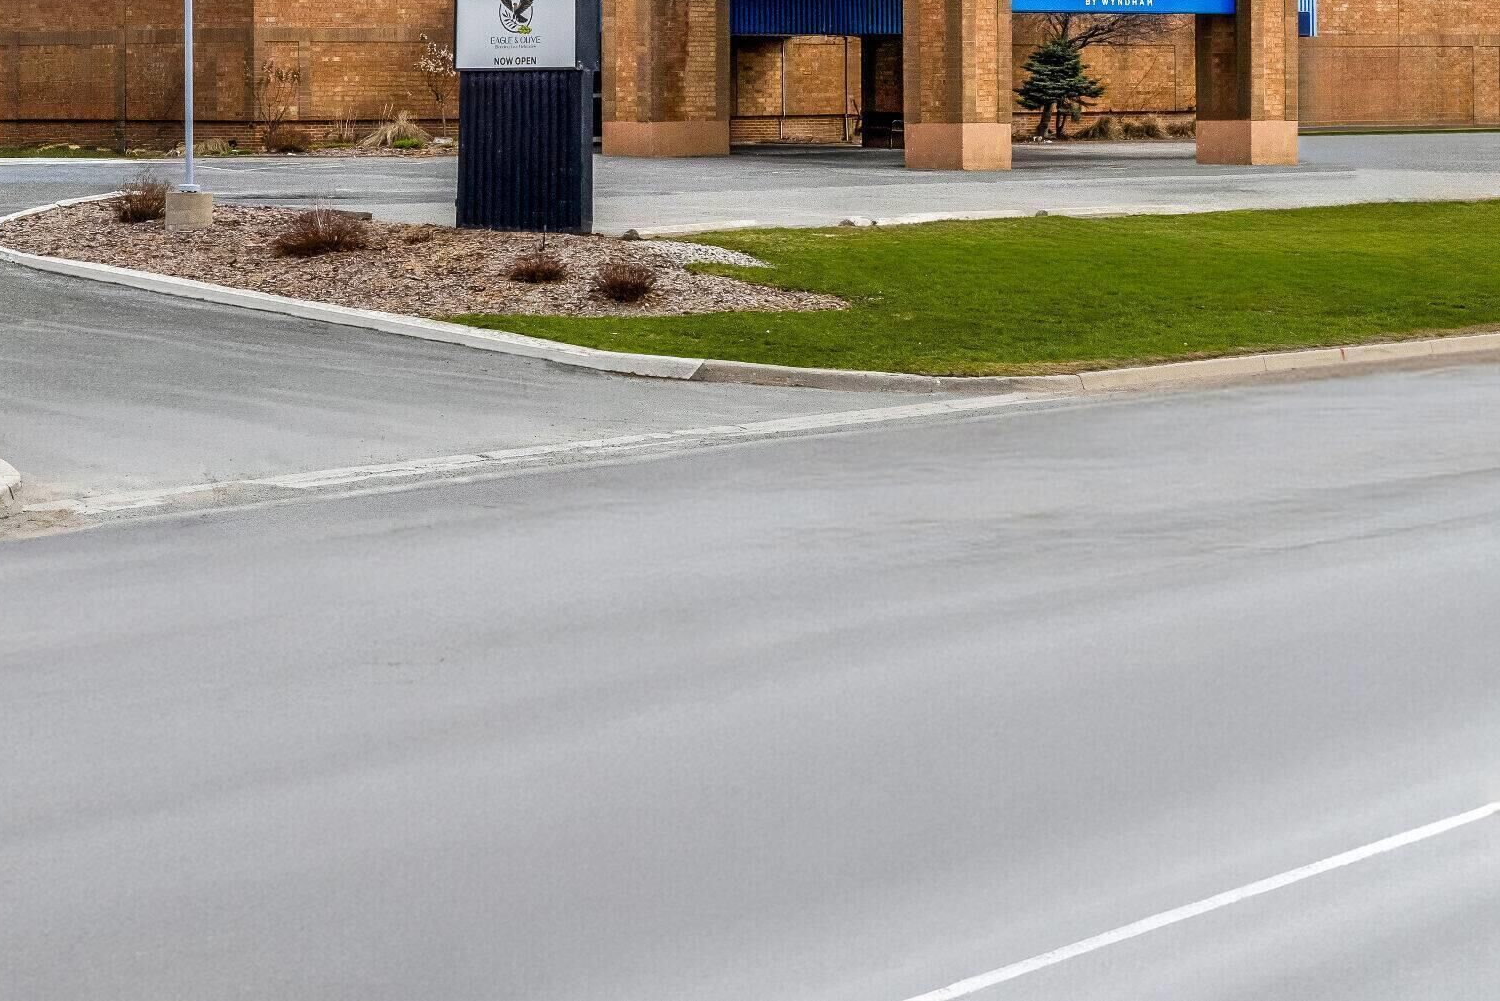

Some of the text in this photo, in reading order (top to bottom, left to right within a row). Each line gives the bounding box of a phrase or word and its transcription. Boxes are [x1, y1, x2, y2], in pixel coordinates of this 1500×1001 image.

[490, 36, 513, 44] EAGLE
[520, 36, 541, 44] OLIVE
[494, 57, 537, 65] NOW OPEN
